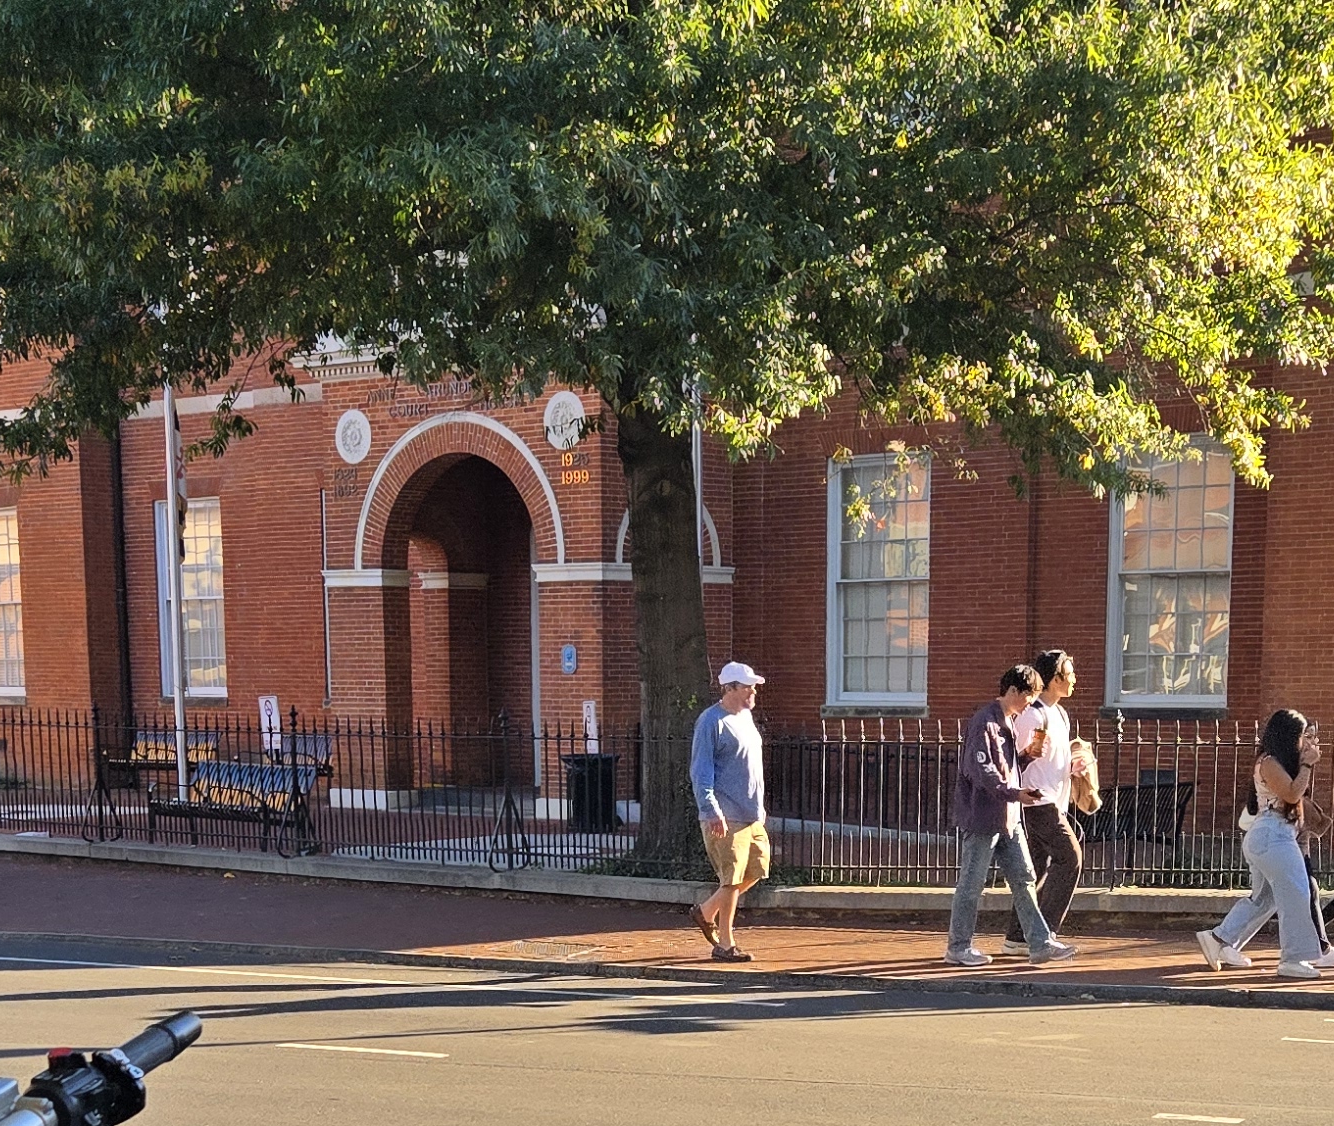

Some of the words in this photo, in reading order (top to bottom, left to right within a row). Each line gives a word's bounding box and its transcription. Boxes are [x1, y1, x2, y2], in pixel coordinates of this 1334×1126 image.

[389, 403, 431, 418] COURT
[561, 452, 589, 467] 1925
[561, 469, 590, 485] 1999
